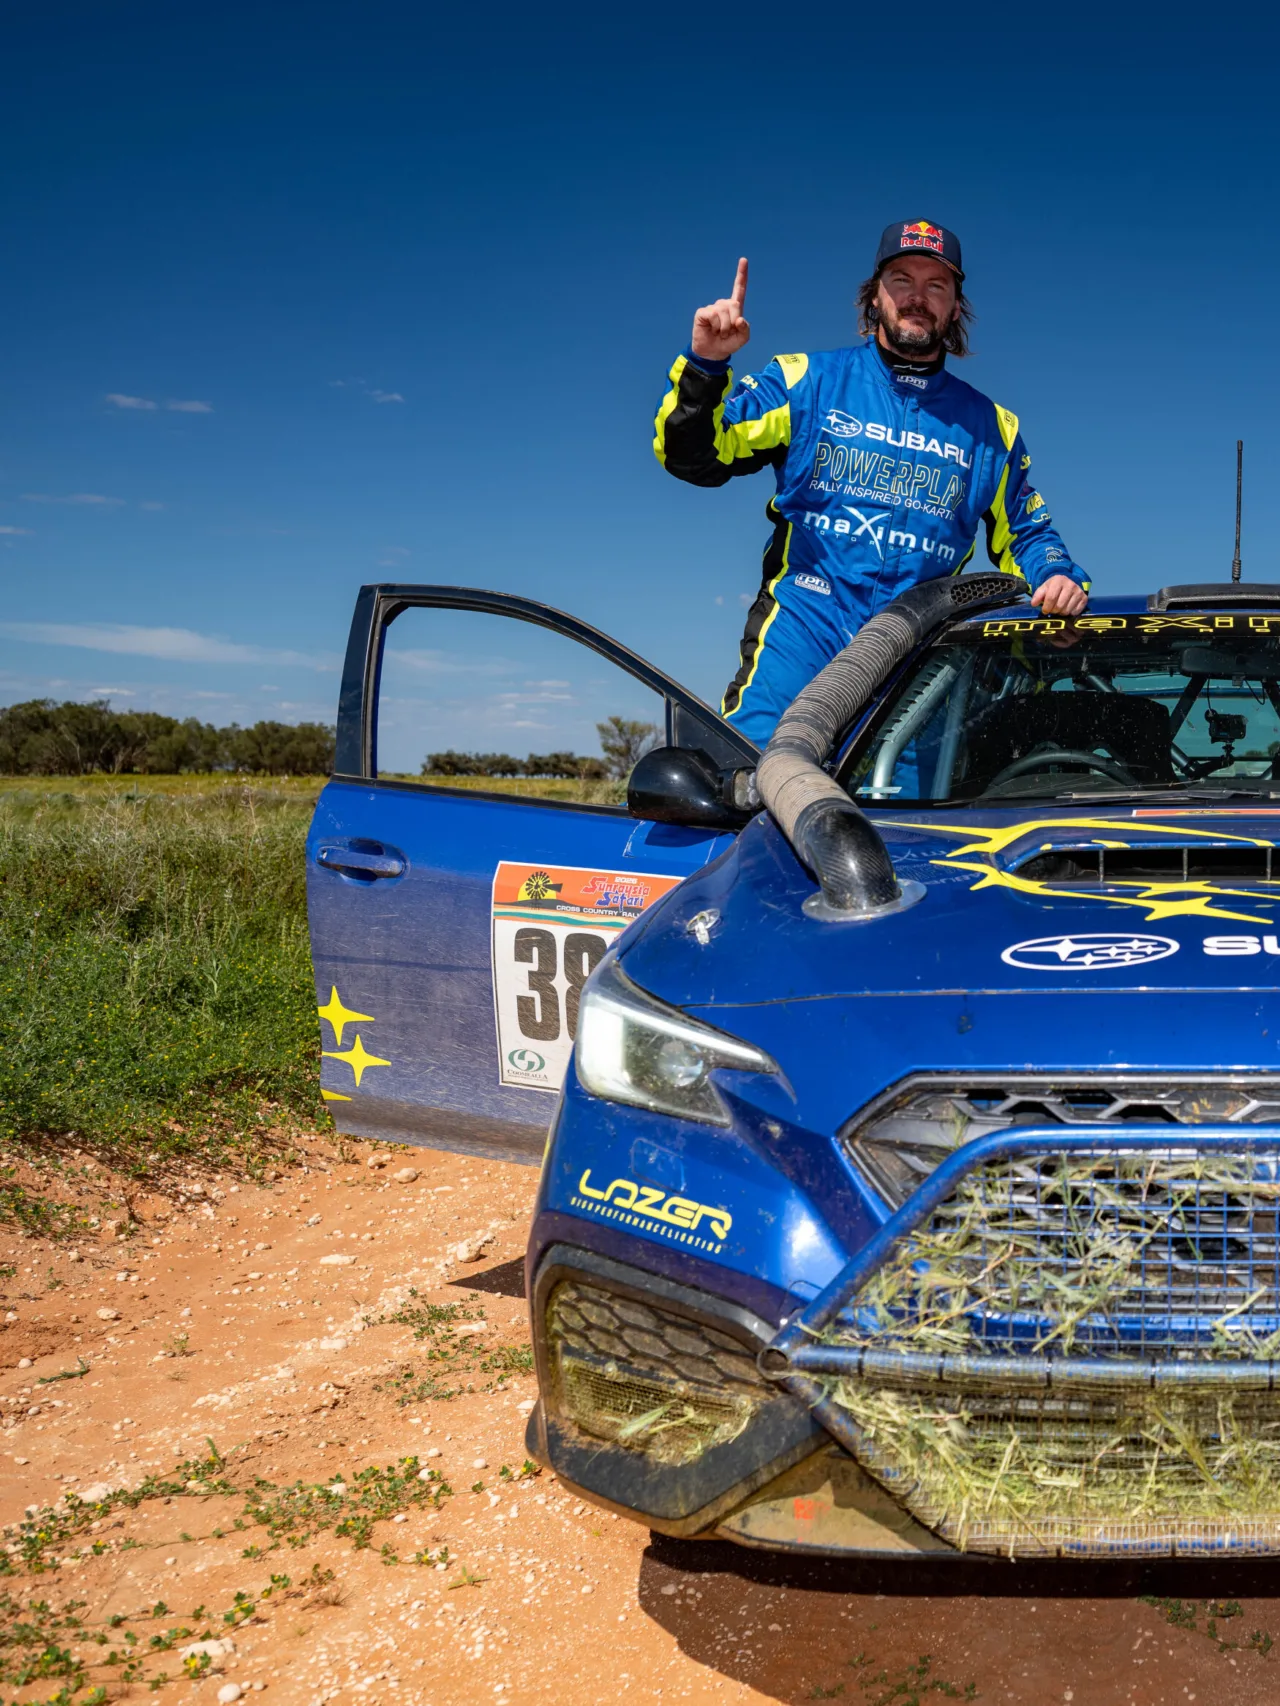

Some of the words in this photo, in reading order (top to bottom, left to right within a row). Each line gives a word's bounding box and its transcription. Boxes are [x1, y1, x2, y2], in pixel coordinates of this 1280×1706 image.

[900, 237, 922, 248] Red
[923, 237, 944, 254] Bull
[864, 422, 973, 470] SUBARU
[809, 480, 843, 493] RALLY
[843, 484, 902, 506] INSPIRED
[799, 574, 830, 589] rpm
[580, 877, 651, 896] Sunraysia
[556, 905, 581, 913] CROSS
[583, 907, 618, 917] COUNTRY
[595, 890, 645, 913] Safari
[578, 1168, 733, 1240] LAZER
